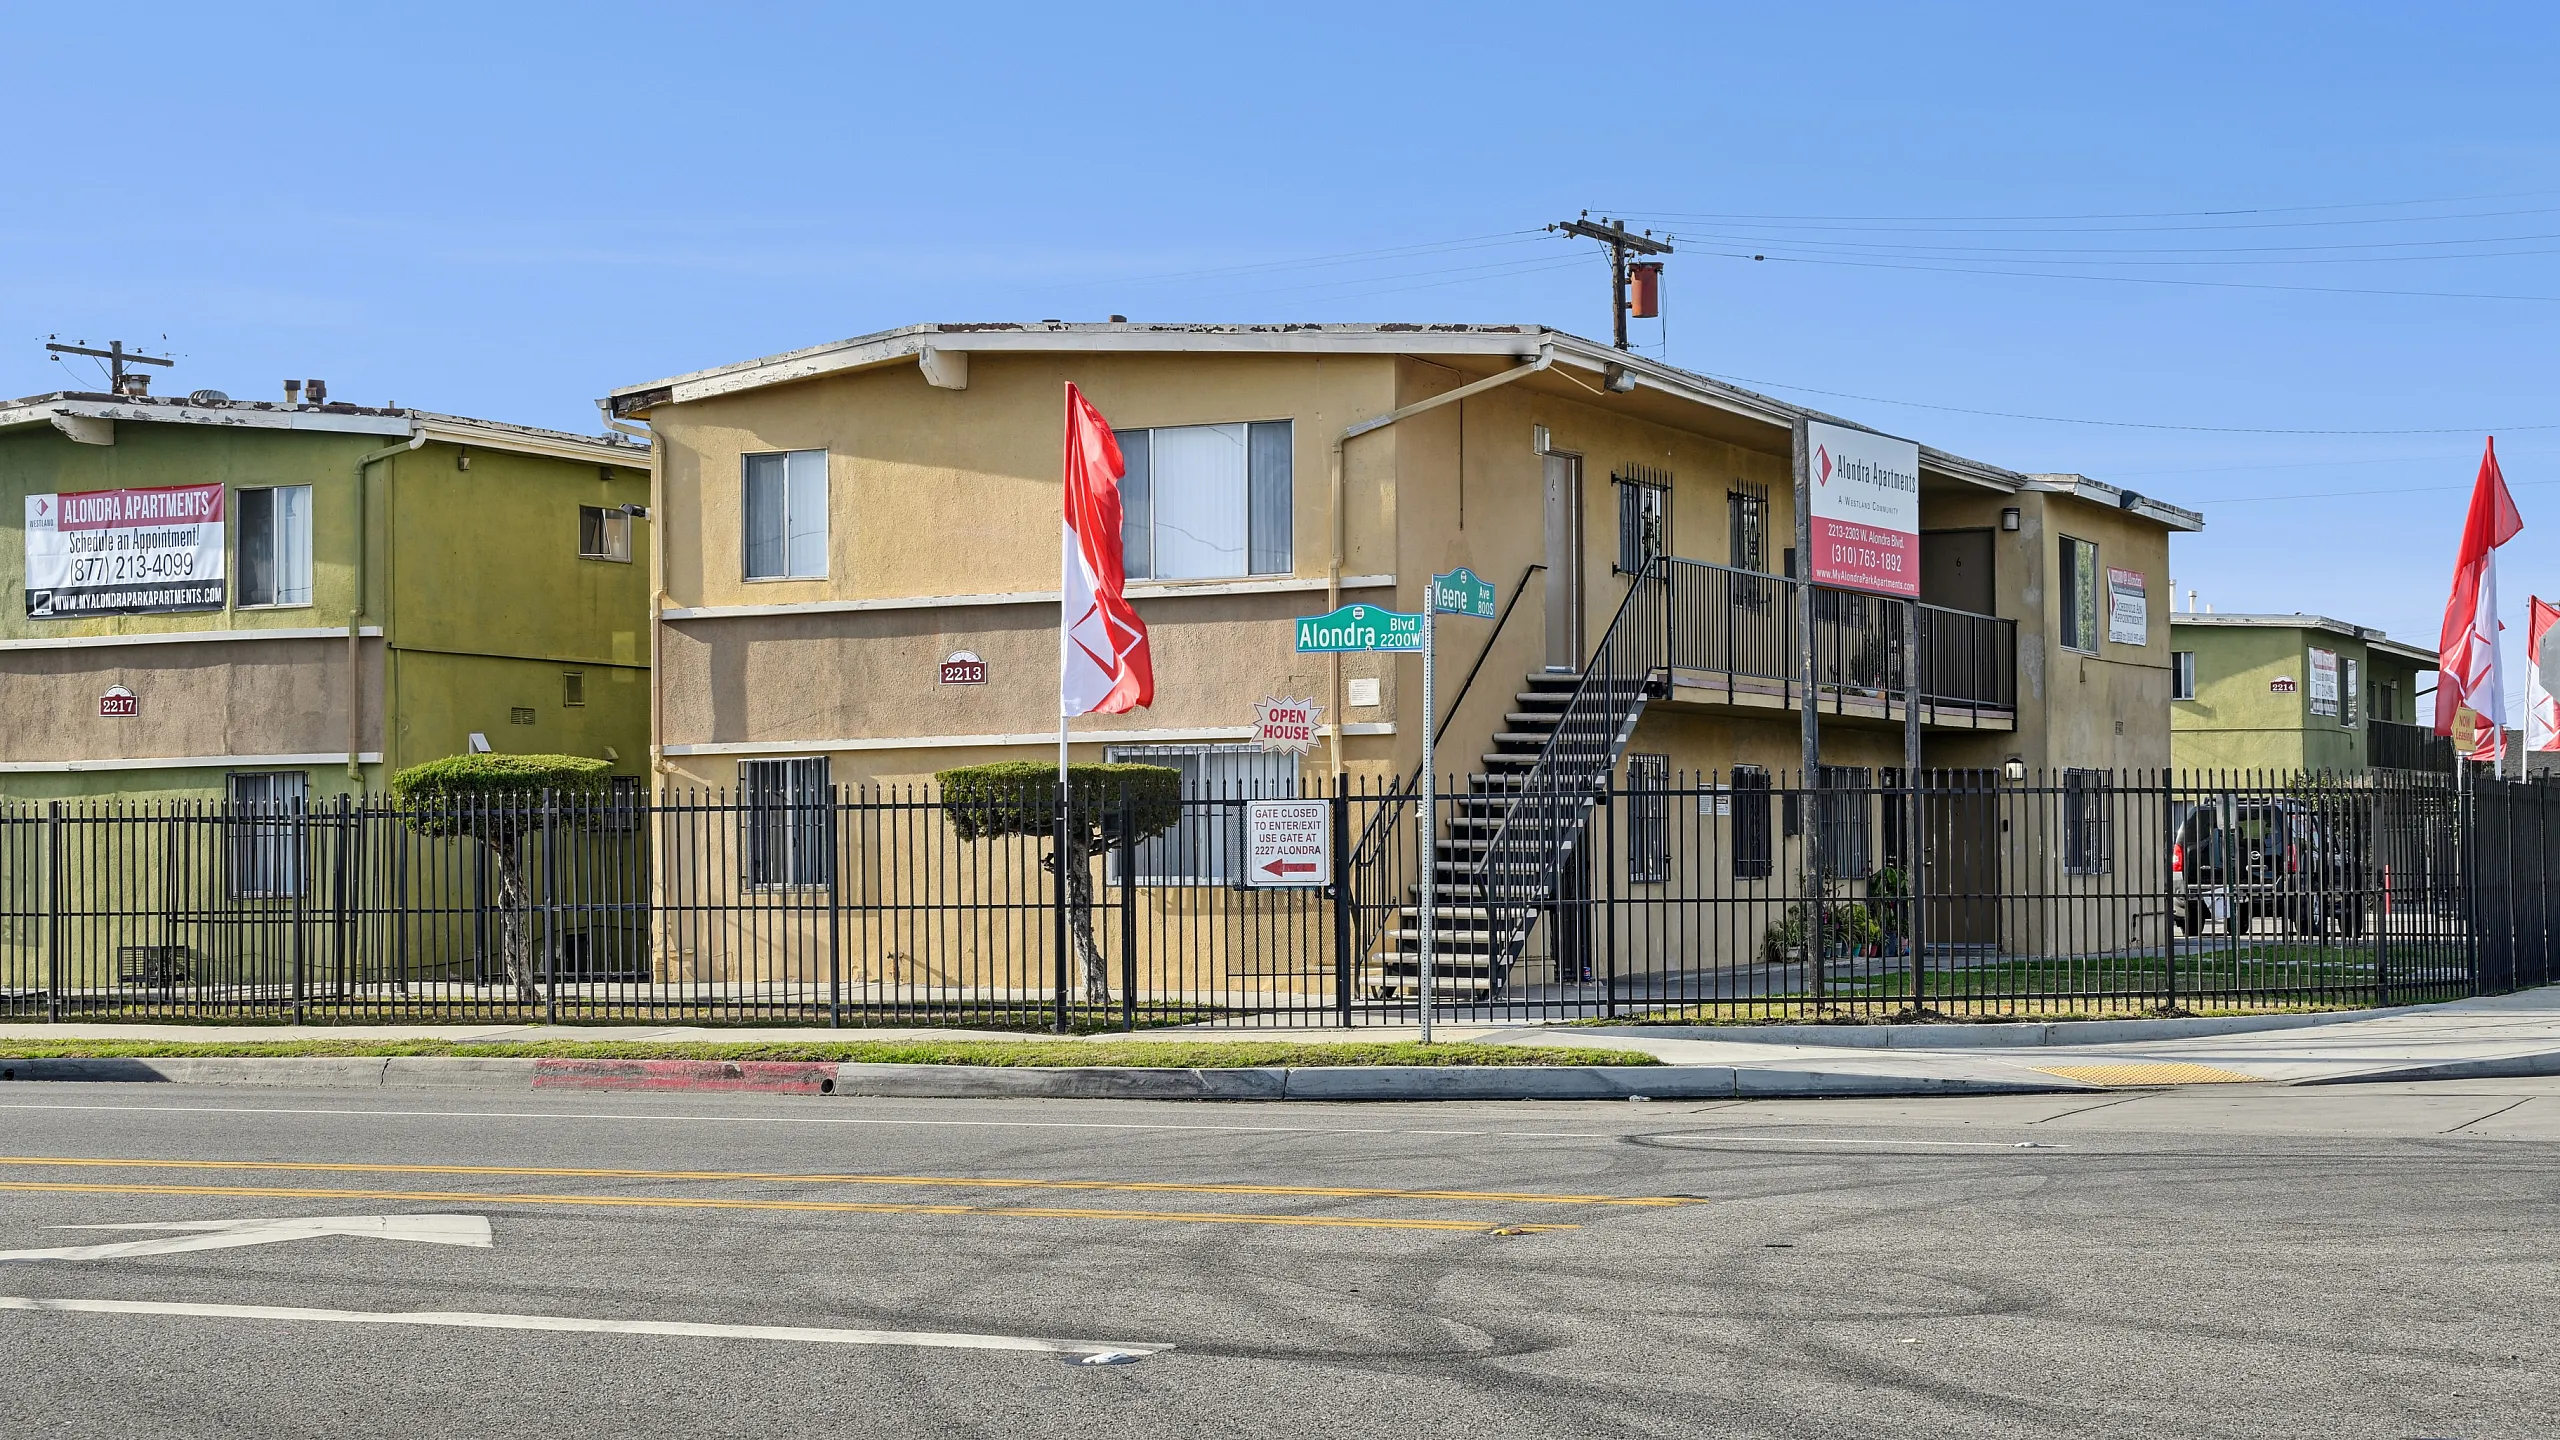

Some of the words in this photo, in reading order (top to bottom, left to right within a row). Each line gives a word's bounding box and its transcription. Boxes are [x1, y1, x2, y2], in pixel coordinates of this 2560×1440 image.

[1838, 454, 1869, 483] Alondra
[1873, 462, 1916, 494] Apartments
[1838, 495, 1843, 504] A
[64, 497, 121, 524] ALONDRA
[124, 491, 209, 520] APARTMENTS
[69, 529, 114, 554] Schedule
[117, 535, 130, 550] an
[133, 524, 200, 555] Appointment!
[1828, 524, 1860, 541] 2213-2303
[1860, 529, 1868, 542] W.
[1869, 531, 1891, 547] Alondra
[1891, 535, 1905, 549] Blvd.
[1832, 543, 1857, 568] (310)
[1859, 548, 1902, 572] 763-1892
[1956, 556, 1961, 567] 6
[70, 556, 109, 586] (877)
[116, 552, 193, 580] 213-4099
[1816, 569, 1915, 592] www.MyAlondraParkApartments.com
[55, 587, 222, 611] WWW.MYALONDRAPARKAPARTMENTS.COM
[1435, 580, 1467, 610] Keene
[1478, 586, 1490, 599] Ave
[1477, 602, 1494, 616] 800S
[1390, 617, 1415, 632] Blvd
[1299, 622, 1376, 648] Alondra
[1380, 633, 1421, 647] 2200W
[945, 667, 982, 681] 2213
[103, 700, 133, 713] 2217
[1269, 708, 1307, 724] OPEN
[1263, 725, 1309, 740] HOUSE
[1255, 809, 1278, 818] GATE
[1281, 808, 1318, 818] CLOSED
[1254, 821, 1266, 830] TO
[1269, 821, 1321, 830] ENTER/EXIT
[1259, 834, 1277, 842] USE
[1280, 834, 1303, 842] GATE
[1305, 833, 1317, 842] AT
[1255, 846, 1274, 855] 2227
[1277, 846, 1321, 855] ALONDRA
